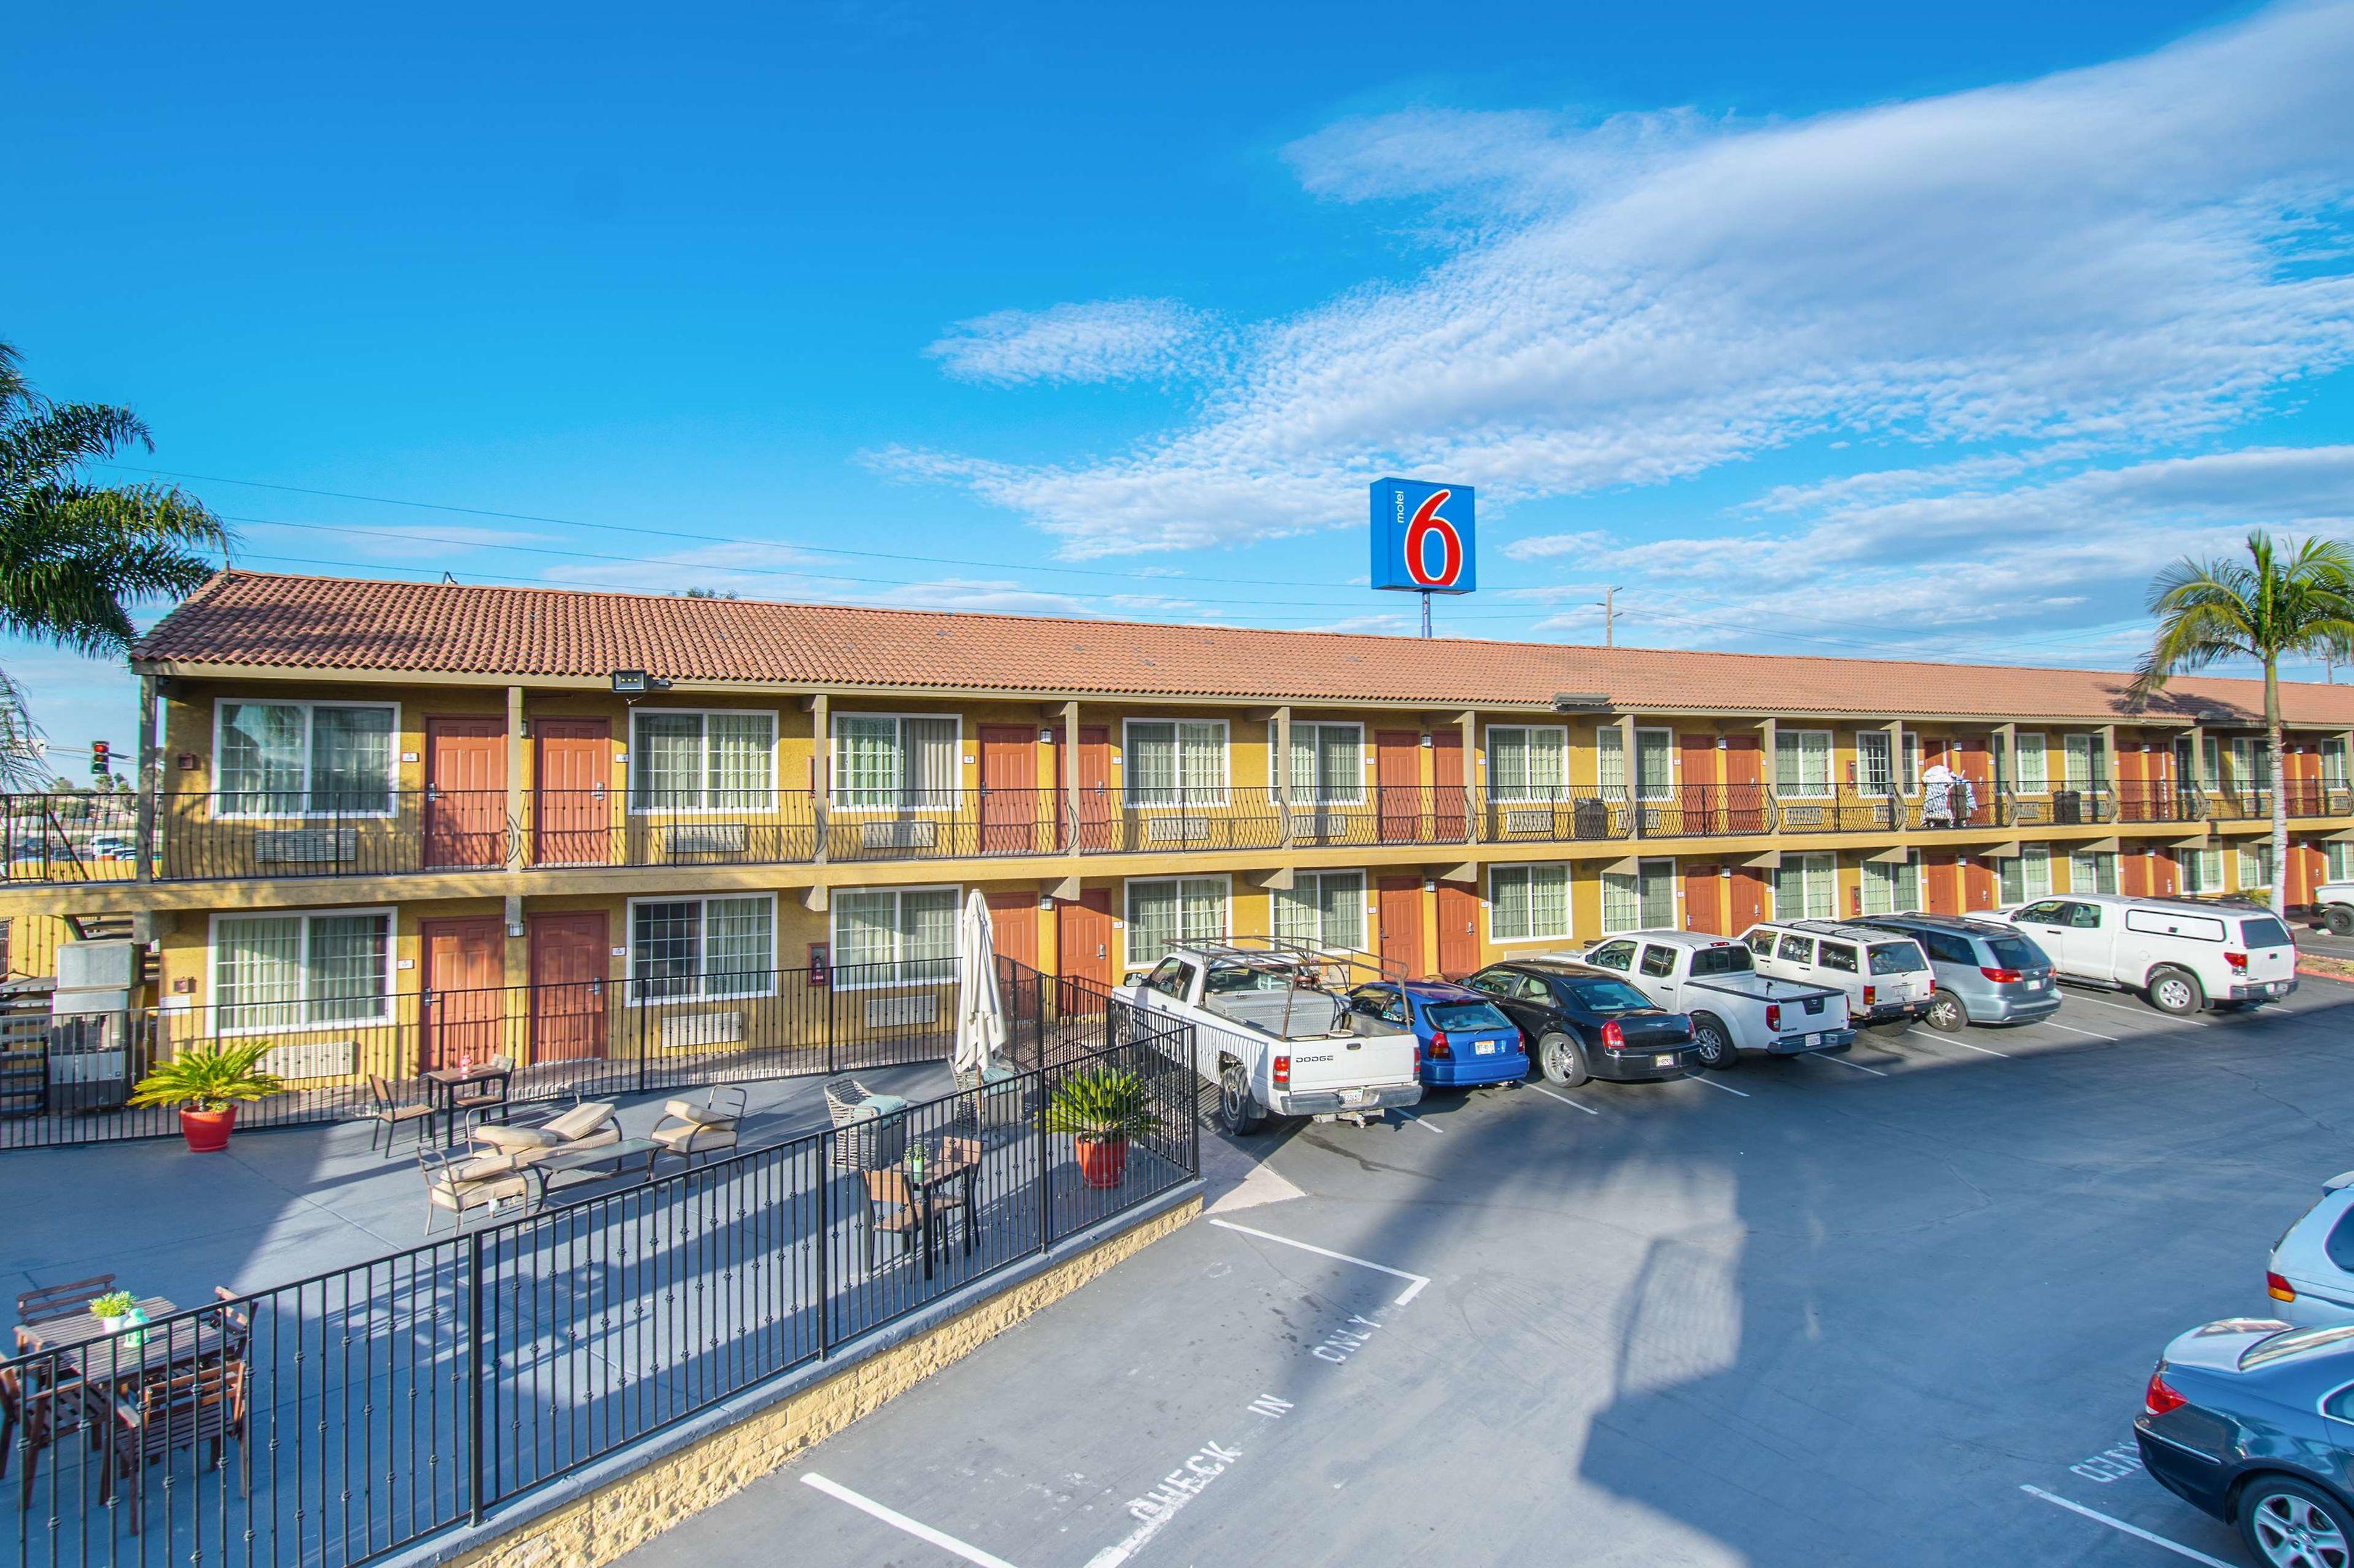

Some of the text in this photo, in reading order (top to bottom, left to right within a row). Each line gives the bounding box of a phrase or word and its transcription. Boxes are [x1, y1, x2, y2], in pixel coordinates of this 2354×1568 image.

[1394, 489, 1463, 587] motel 6
[1127, 1314, 1381, 1522] CHECK IN ONLY
